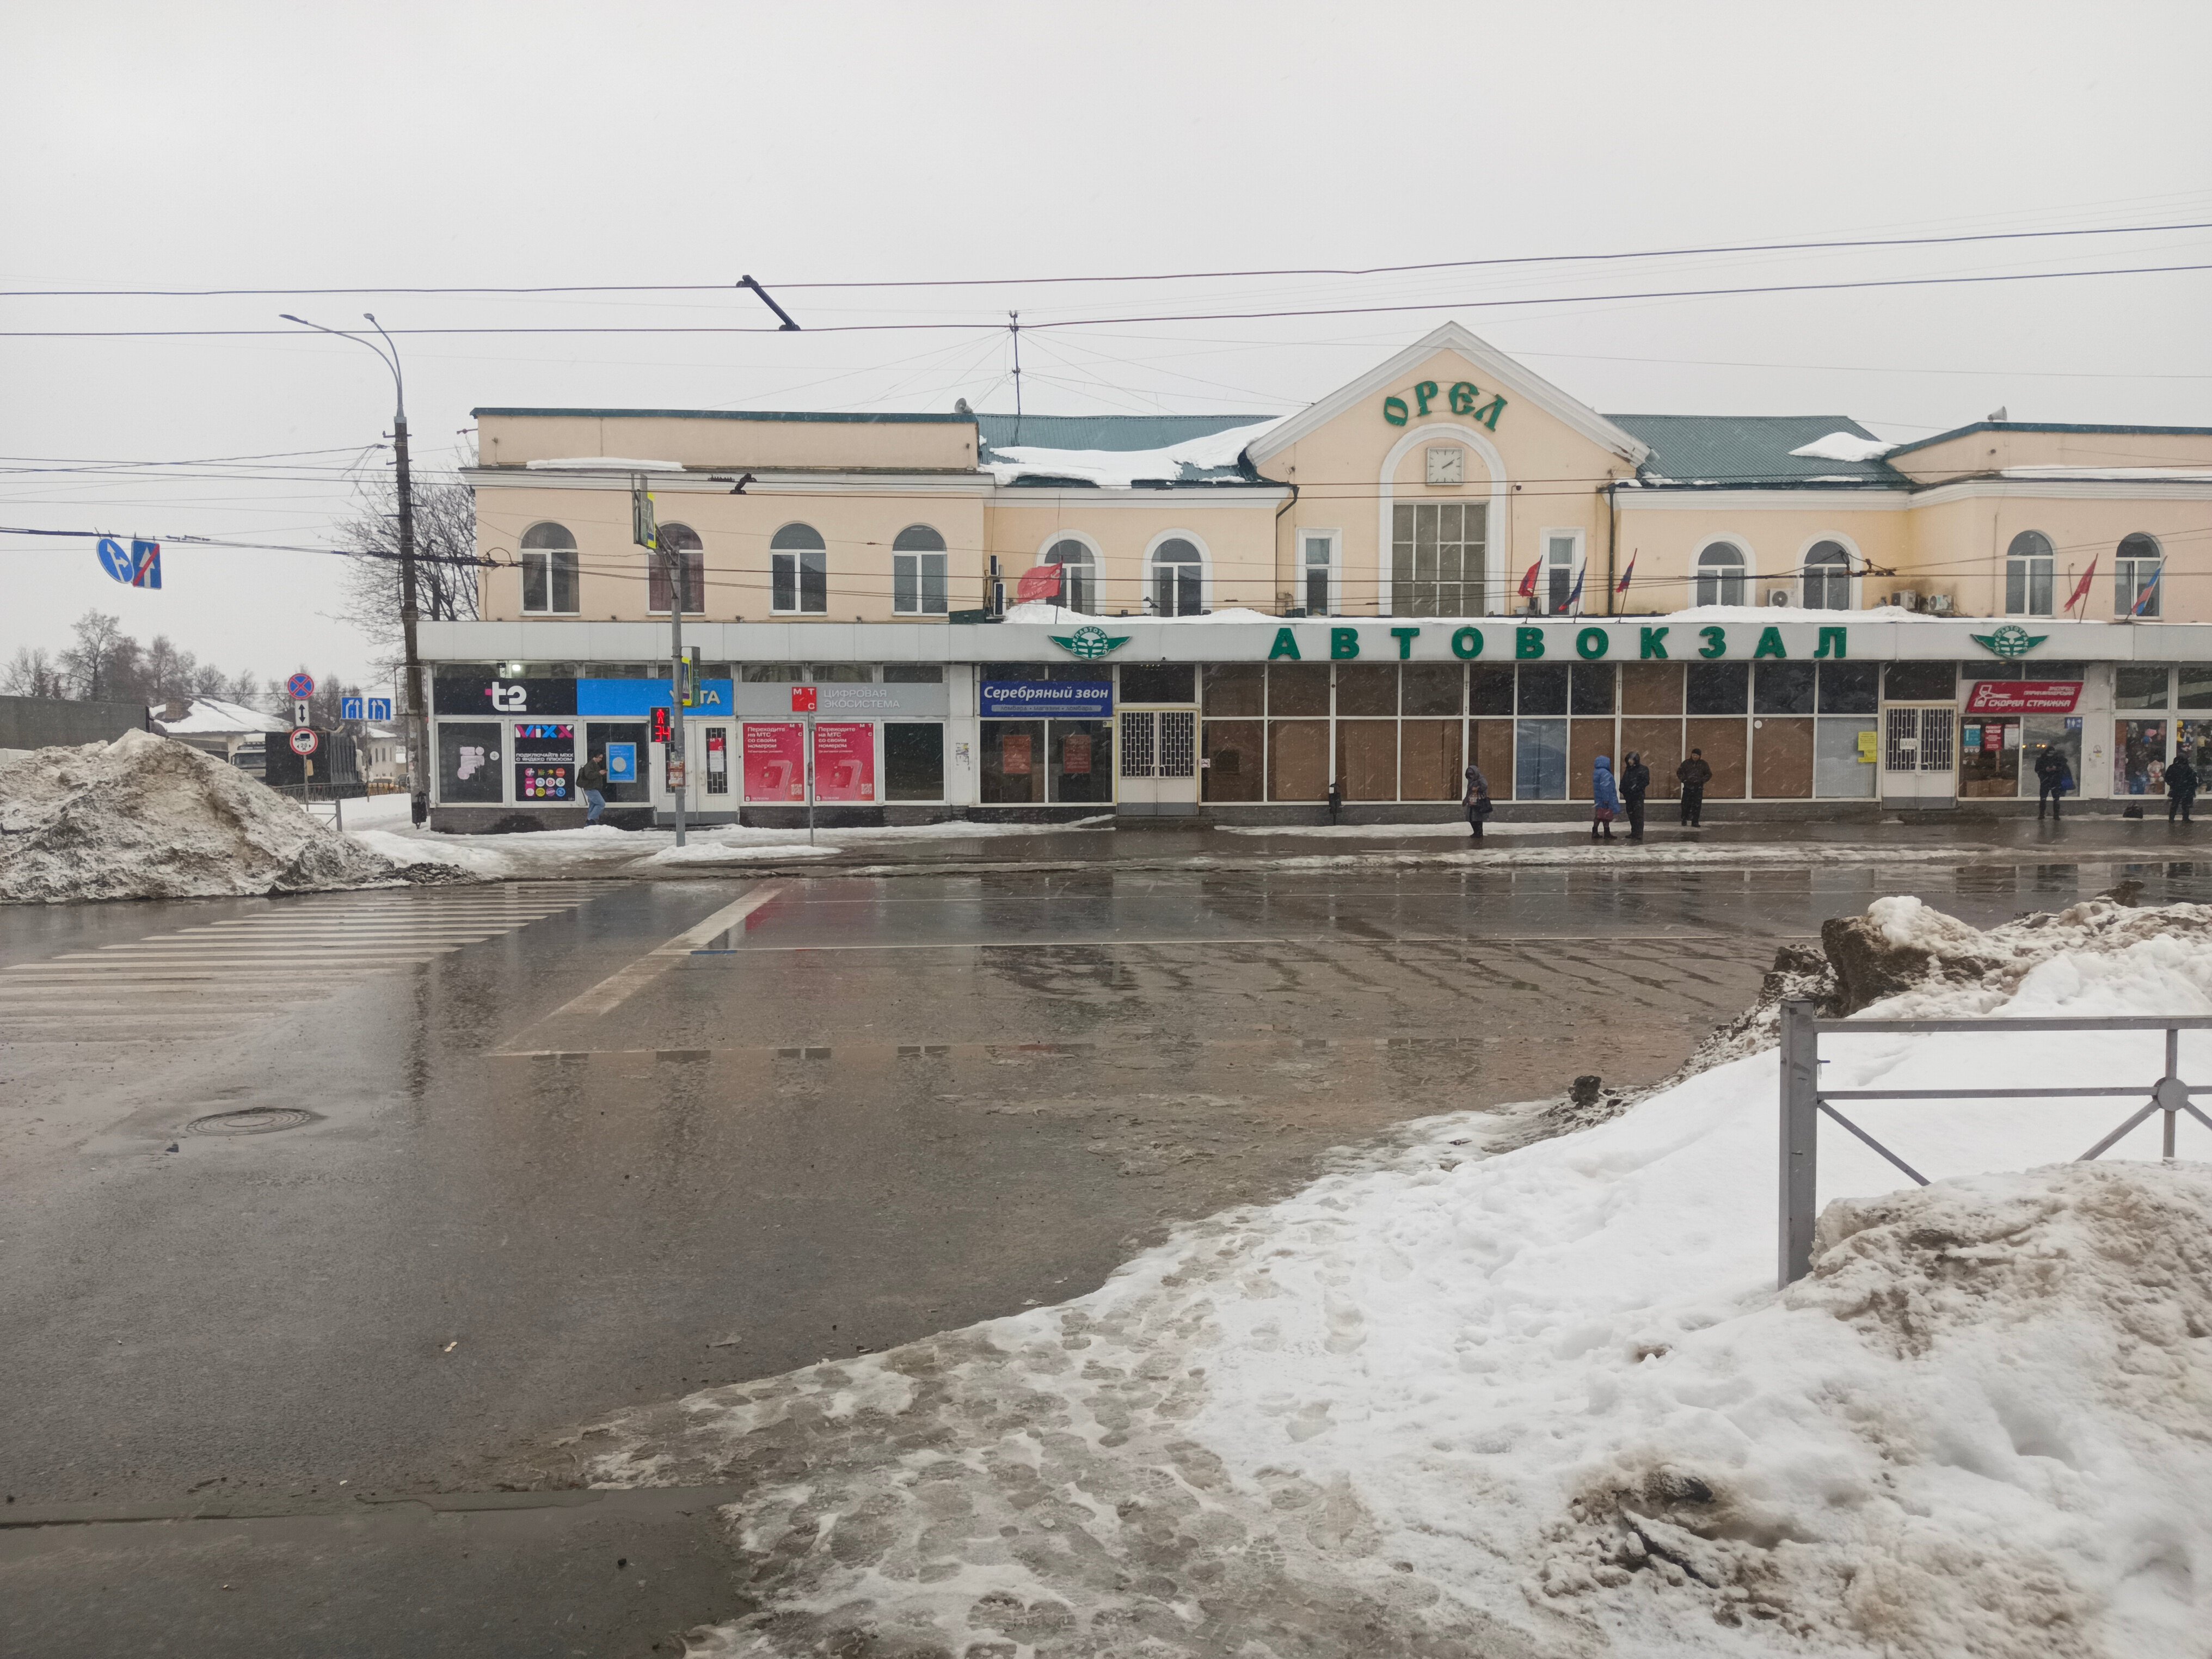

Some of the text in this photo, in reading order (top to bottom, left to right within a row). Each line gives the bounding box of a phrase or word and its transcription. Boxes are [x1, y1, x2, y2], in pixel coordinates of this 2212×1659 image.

[1268, 626, 1847, 660] АВТОВОКЗАЛ
[491, 681, 527, 711] t2
[824, 689, 887, 698] ЦИФРОВАЯ
[984, 686, 1109, 701] Серебряный звон
[824, 700, 900, 708] ЭКОСИСТЕМА
